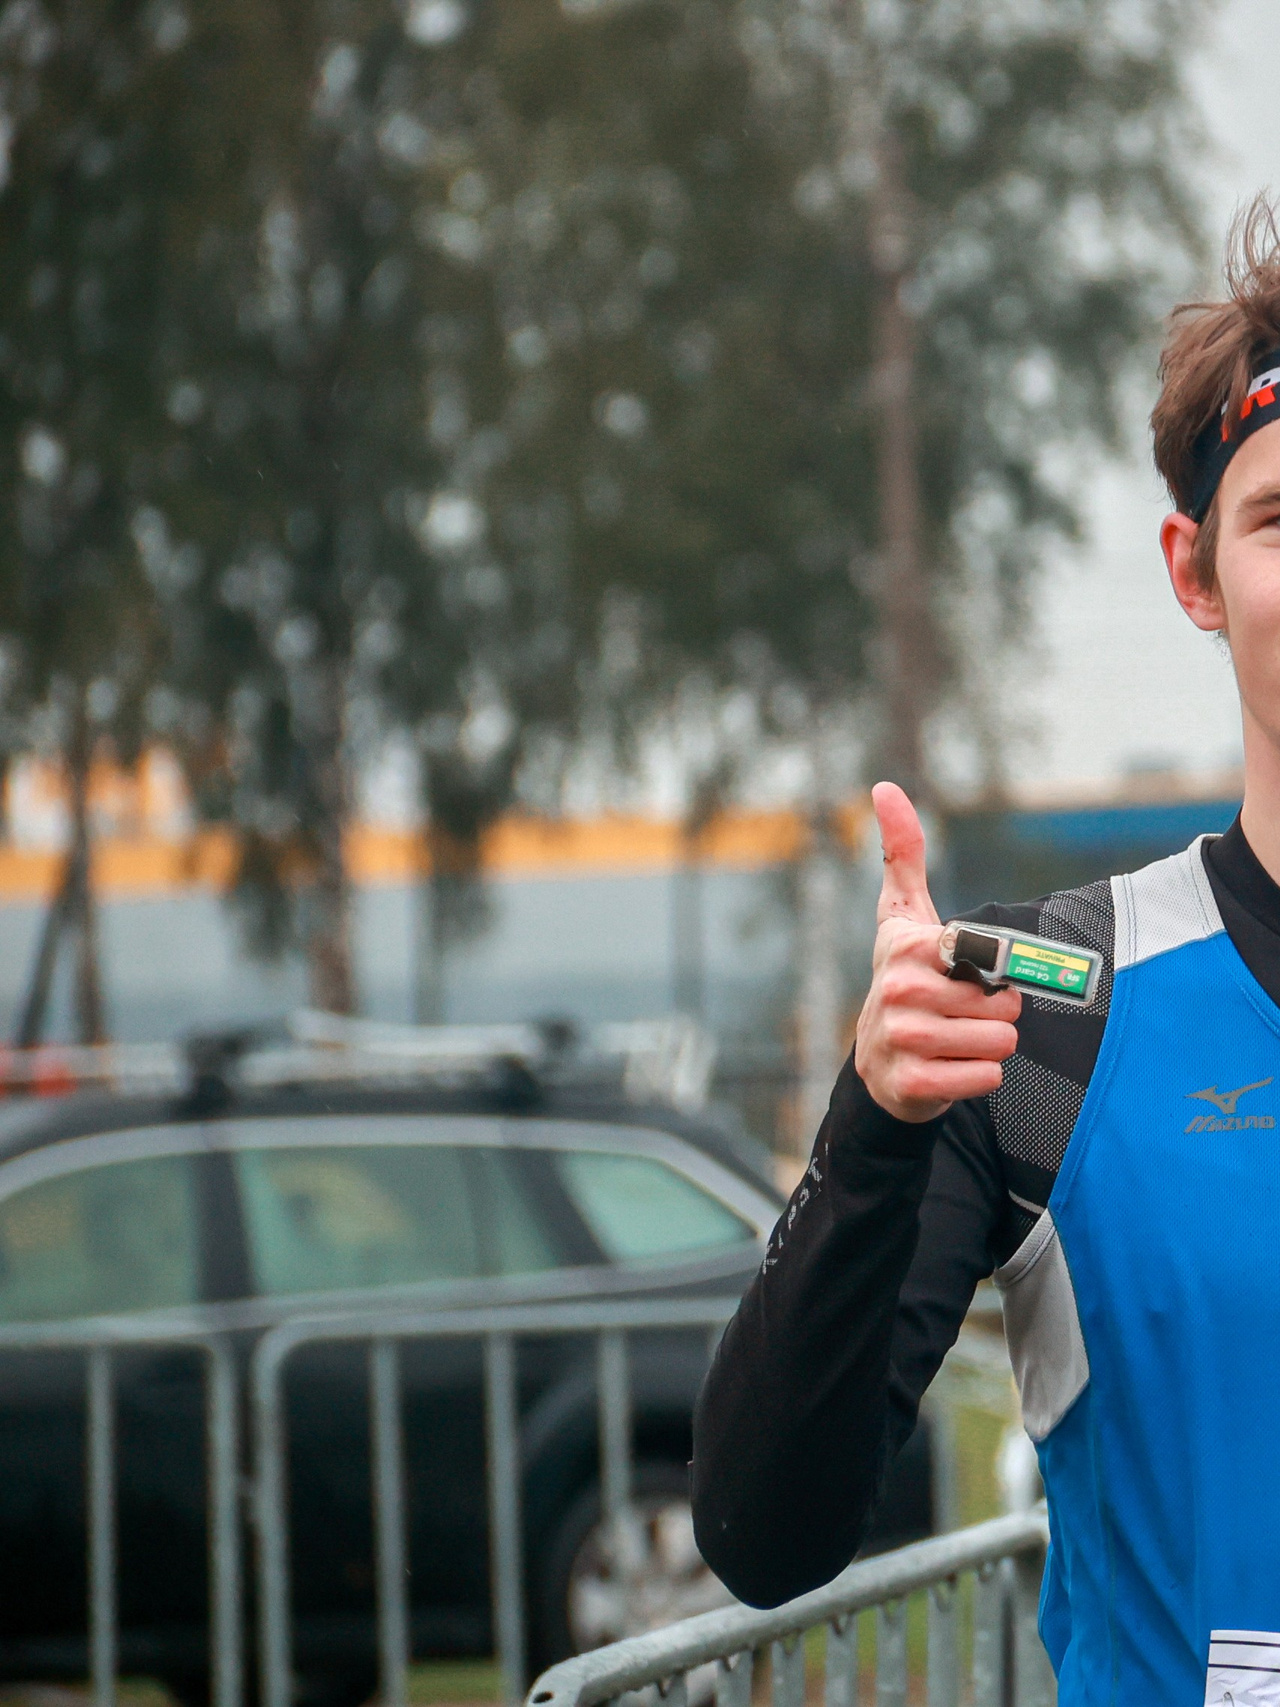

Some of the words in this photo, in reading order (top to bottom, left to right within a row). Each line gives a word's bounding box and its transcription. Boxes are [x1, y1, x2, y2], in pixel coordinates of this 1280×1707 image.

[1036, 952, 1065, 963] PRIVATE
[1015, 967, 1036, 976] card
[1037, 972, 1049, 981] C4
[1184, 1116, 1276, 1133] MIZUNO
